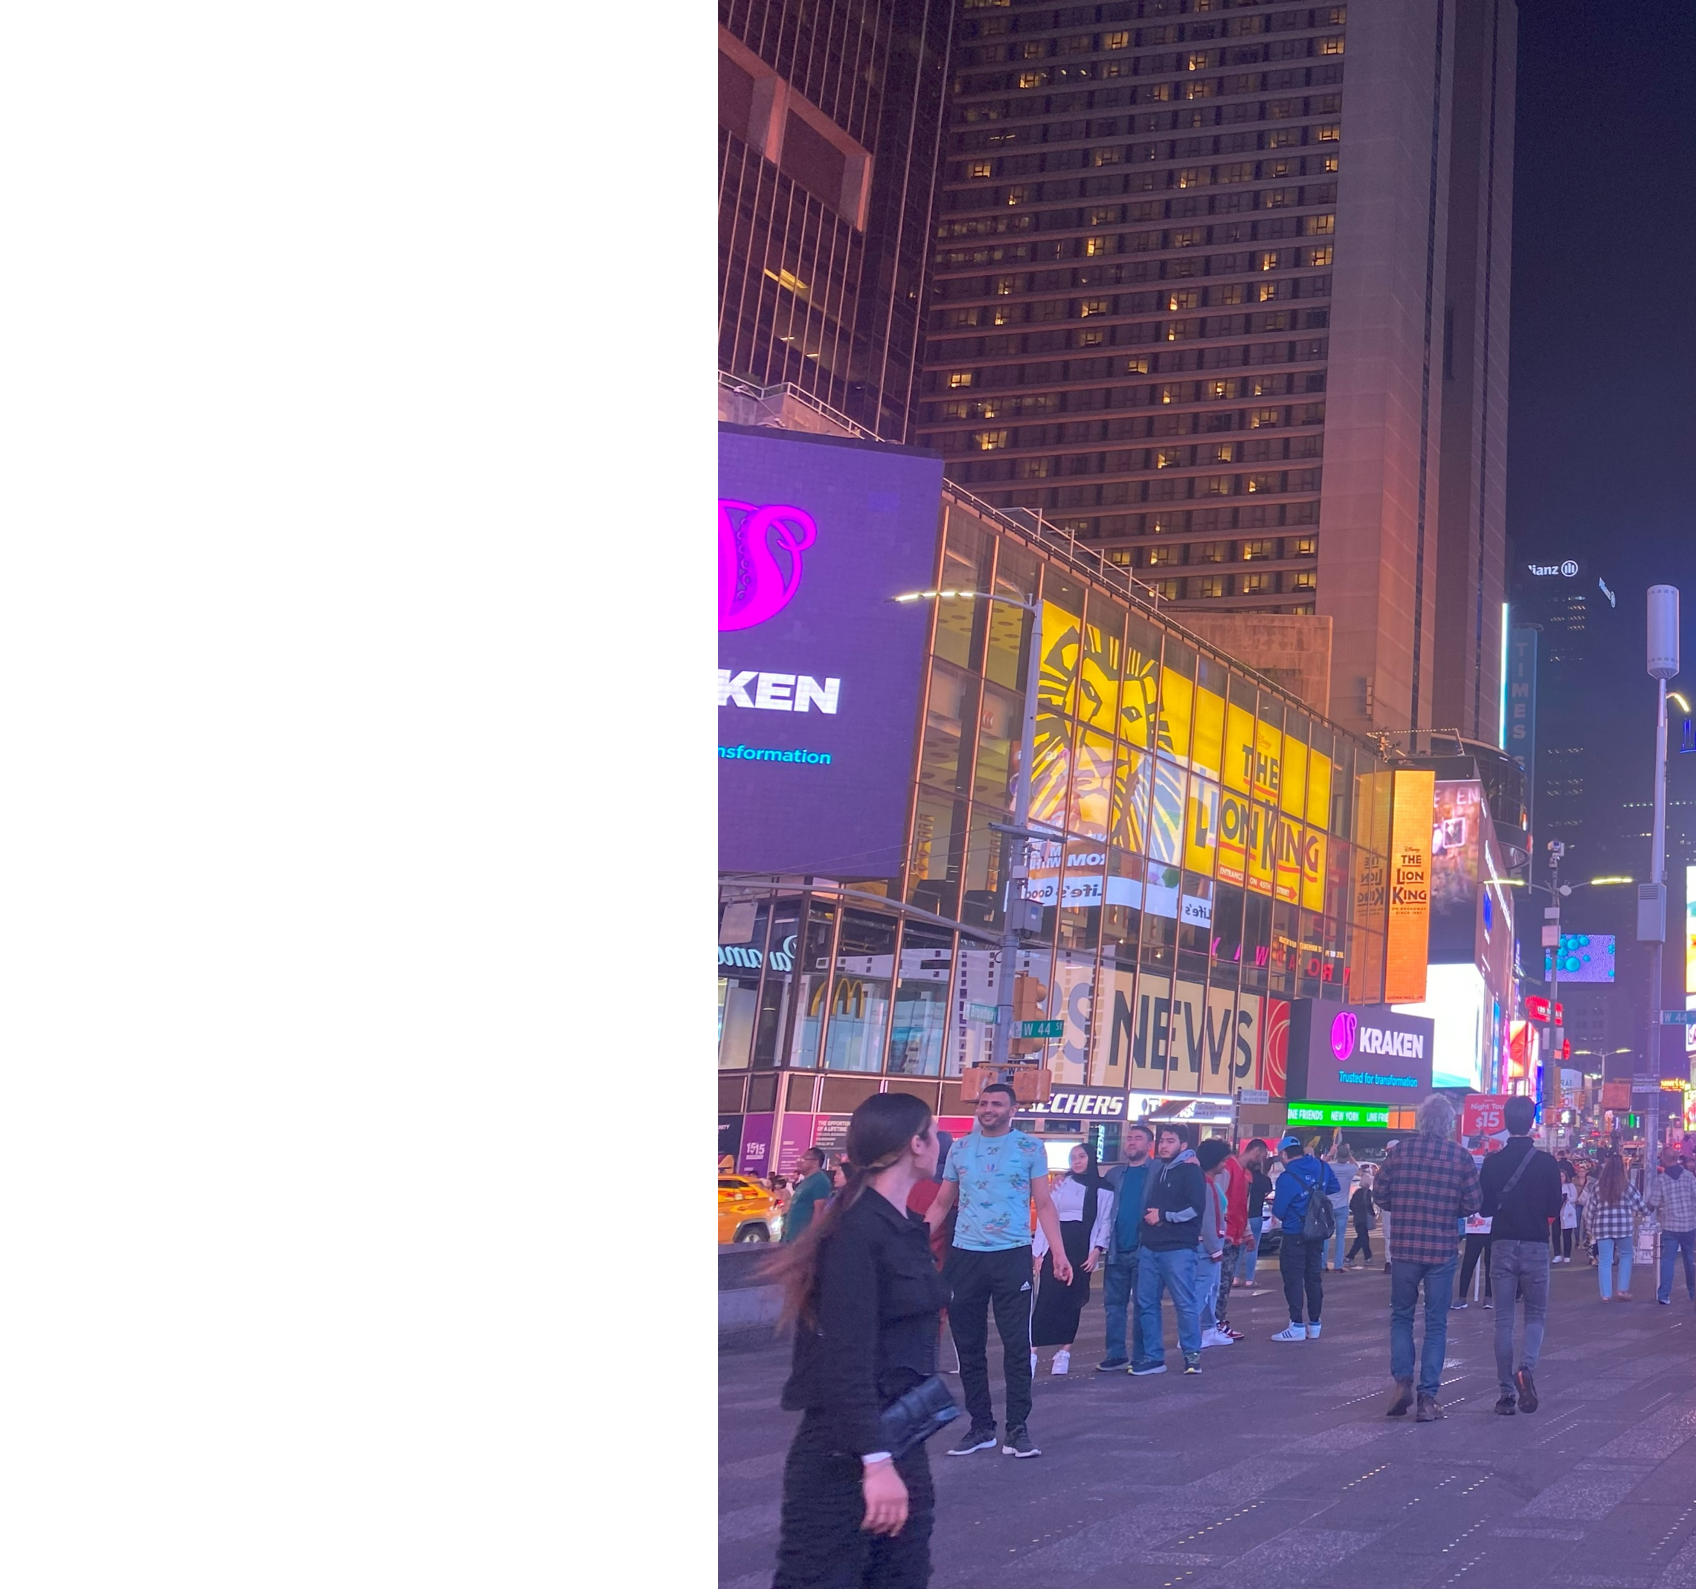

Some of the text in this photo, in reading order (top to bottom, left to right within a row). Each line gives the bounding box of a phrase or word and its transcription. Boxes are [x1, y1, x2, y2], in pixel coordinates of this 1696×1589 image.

[1511, 642, 1529, 739] TIMES
[1242, 744, 1280, 790] THE
[1261, 799, 1319, 874] KING
[1401, 855, 1422, 864] THE
[1219, 866, 1244, 882] ENTRANCE
[1250, 877, 1258, 886] ON
[1259, 880, 1272, 891] 45TH
[1397, 868, 1424, 885] LION
[1392, 886, 1427, 905] KING
[1664, 1013, 1687, 1023] W 44
[1024, 1024, 1034, 1036] W
[1038, 1022, 1051, 1035] 44
[1109, 989, 1253, 1080] NEWS
[1359, 1026, 1424, 1059] KRAKEN
[1339, 1070, 1418, 1088] Trusted for transformation
[1299, 1109, 1323, 1121] FRIENDS
[1331, 1110, 1344, 1121] NEW
[1345, 1111, 1360, 1122] YORK
[1471, 1103, 1490, 1111] Night
[1475, 1111, 1499, 1128] $15
[746, 1142, 765, 1154] 1515
